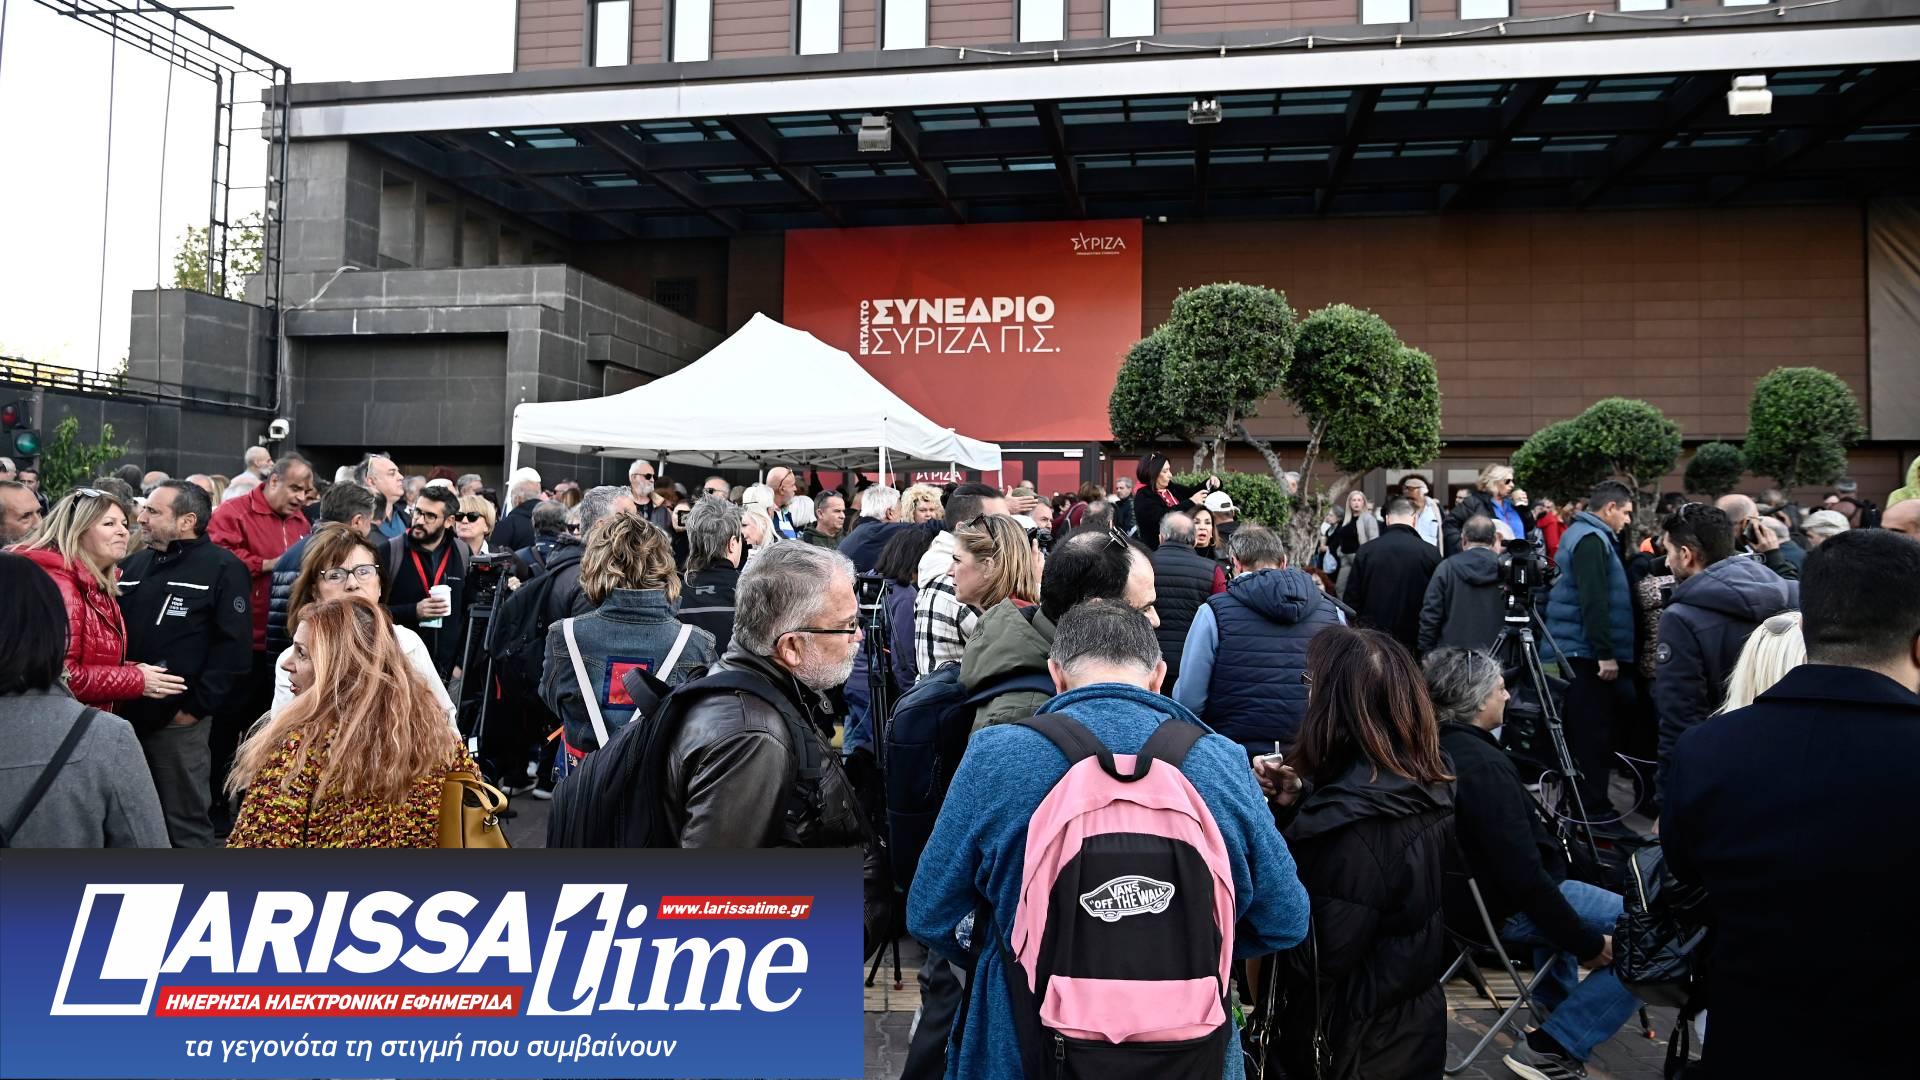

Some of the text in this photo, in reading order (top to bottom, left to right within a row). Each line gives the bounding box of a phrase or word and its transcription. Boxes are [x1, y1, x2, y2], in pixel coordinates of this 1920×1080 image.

[1070, 232, 1126, 250] ΣΥΡΙΖΑ
[872, 296, 1055, 324] ΣΥΝΕΔΡΙΟ
[860, 300, 869, 355] ΕΚΤΑΚΤΟ
[871, 325, 1061, 354] ΣΥΡΙΖΑ Π.Σ.
[1108, 881, 1140, 899] VANS
[1113, 893, 1138, 908] THE
